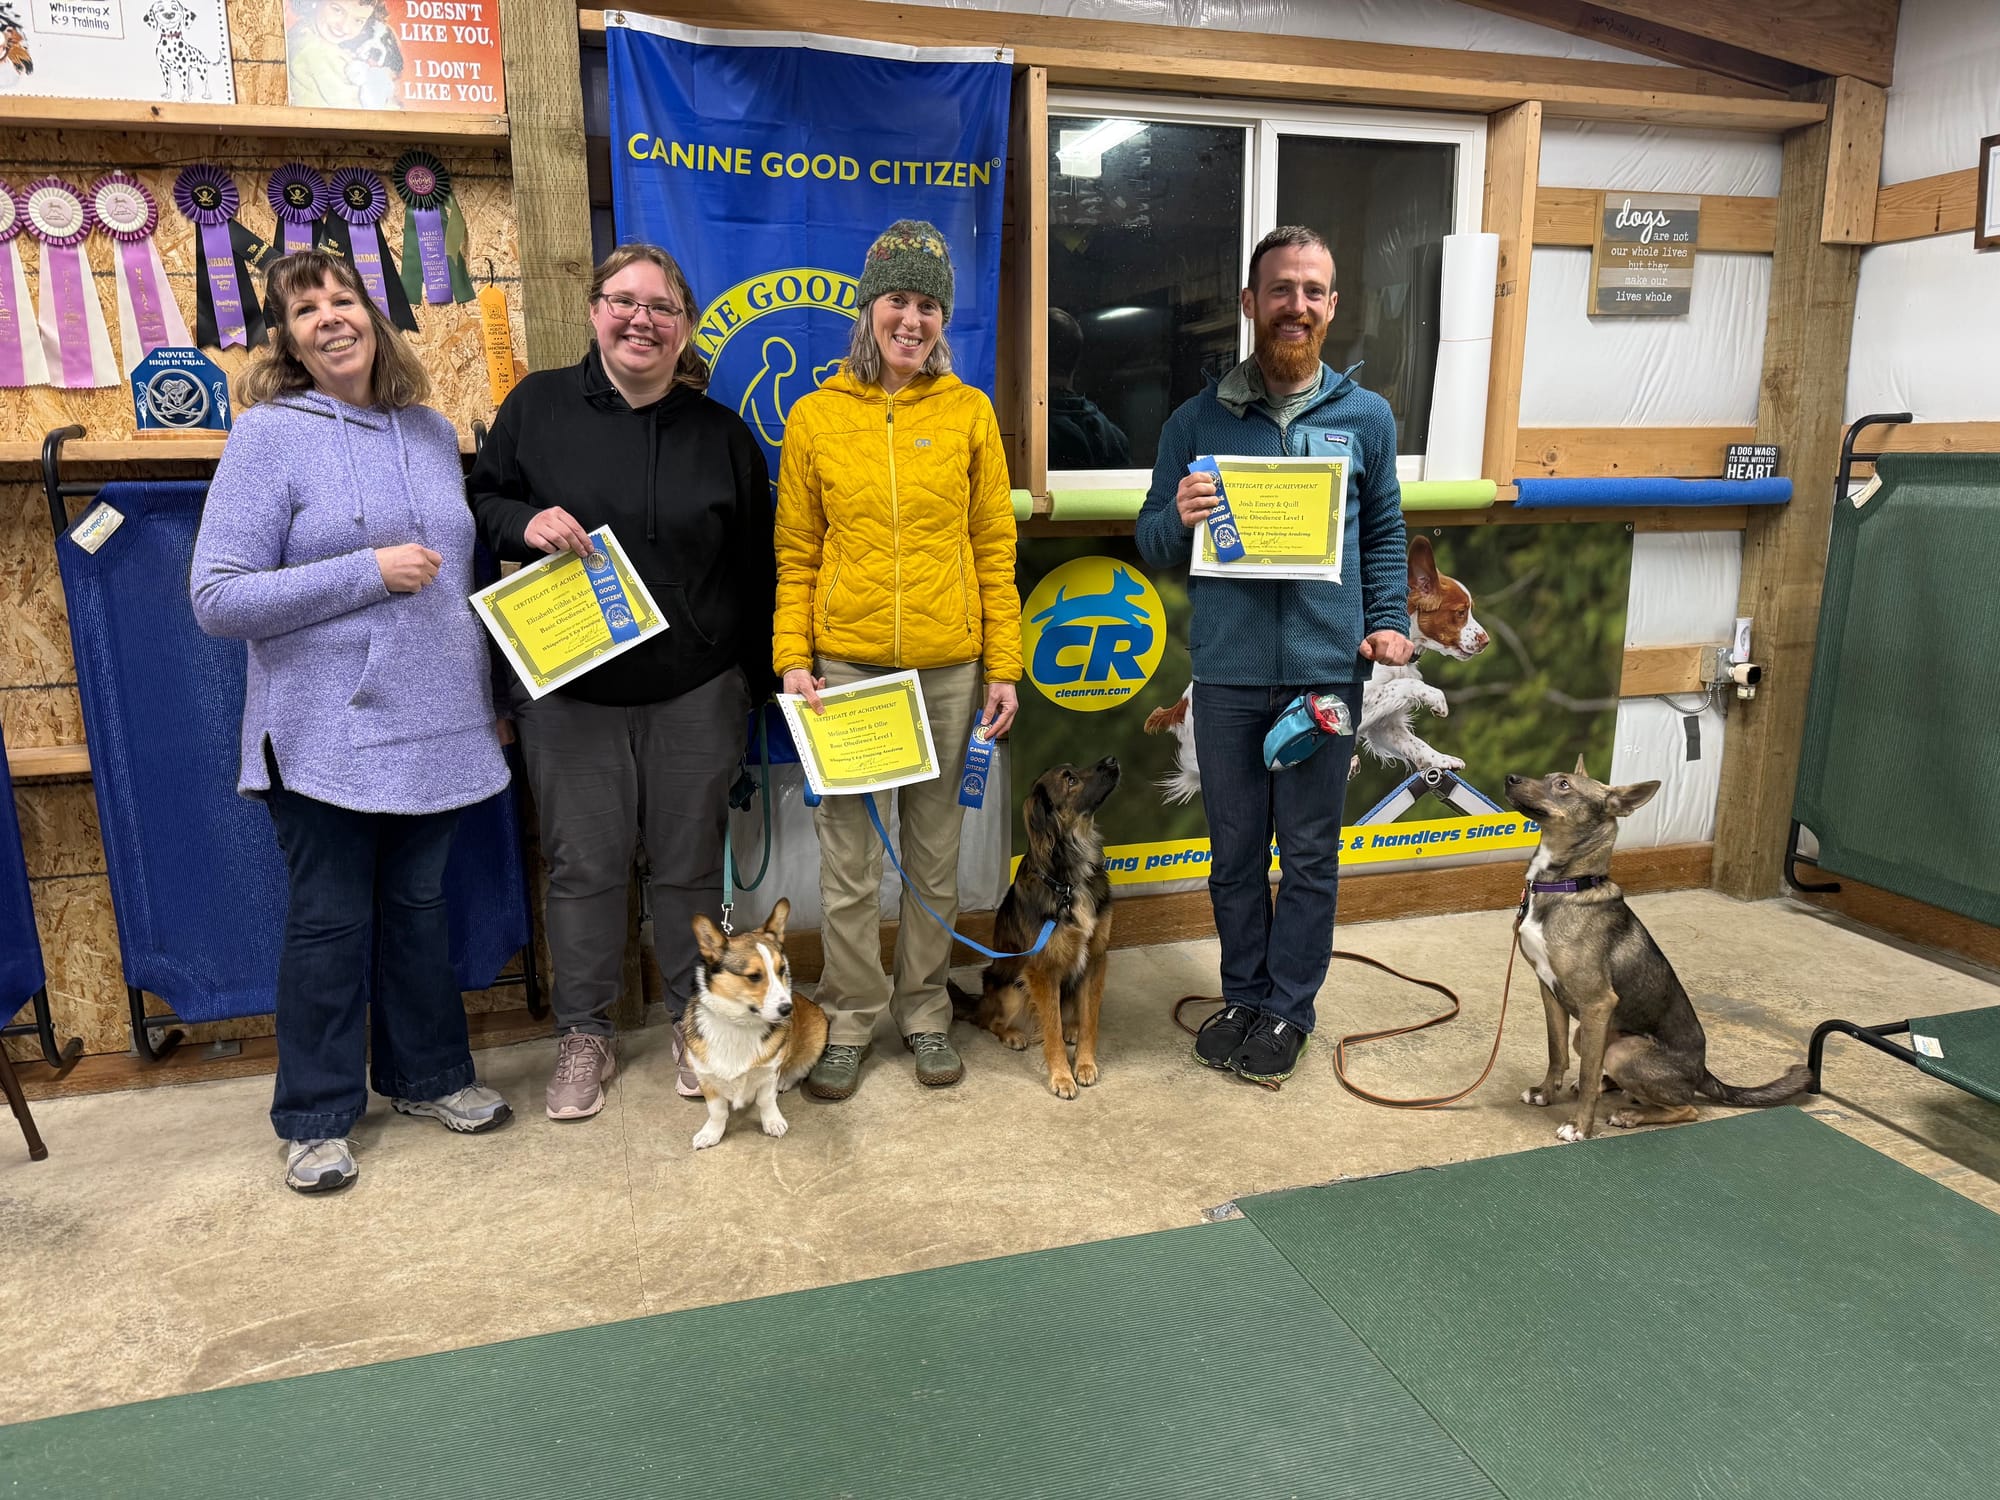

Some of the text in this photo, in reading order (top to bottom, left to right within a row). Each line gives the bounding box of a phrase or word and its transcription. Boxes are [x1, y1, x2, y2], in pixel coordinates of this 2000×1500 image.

[49, 2, 110, 16] Whispering X
[406, 0, 482, 21] DOESN'T
[51, 14, 110, 30] K-9 Training
[400, 23, 494, 48] LIKE YOU,
[414, 60, 480, 80] I DON'T
[404, 82, 497, 102] LIKE YOU.
[628, 134, 752, 175] CANINE
[761, 152, 860, 181] GOOD
[1616, 198, 1670, 244] dogs
[1674, 232, 1689, 241] not
[1611, 246, 1688, 257] our whole lives
[1628, 260, 1669, 273] but they
[1625, 276, 1648, 285] make
[747, 276, 858, 310] GOOD
[1616, 291, 1672, 302] lives whole
[1730, 446, 1776, 456] A DOG WAGS
[1727, 464, 1774, 479] HEART
[593, 574, 616, 586] CANINE
[599, 584, 616, 594] GOOD
[513, 587, 550, 611] CERTIFICATE
[551, 584, 559, 592] OF
[526, 606, 554, 626] Elizabeth
[539, 623, 555, 634] Basic
[556, 608, 585, 626] Obedience
[1032, 624, 1153, 685] CR
[1055, 687, 1131, 698] cleanrun.com
[857, 702, 897, 715] ACHIEVEMENT
[844, 737, 872, 747] Obedience
[874, 734, 889, 742] Level
[970, 746, 989, 755] CANINE
[1350, 836, 1365, 850] &
[1371, 828, 1460, 848] handlers
[1466, 822, 1516, 840] since
